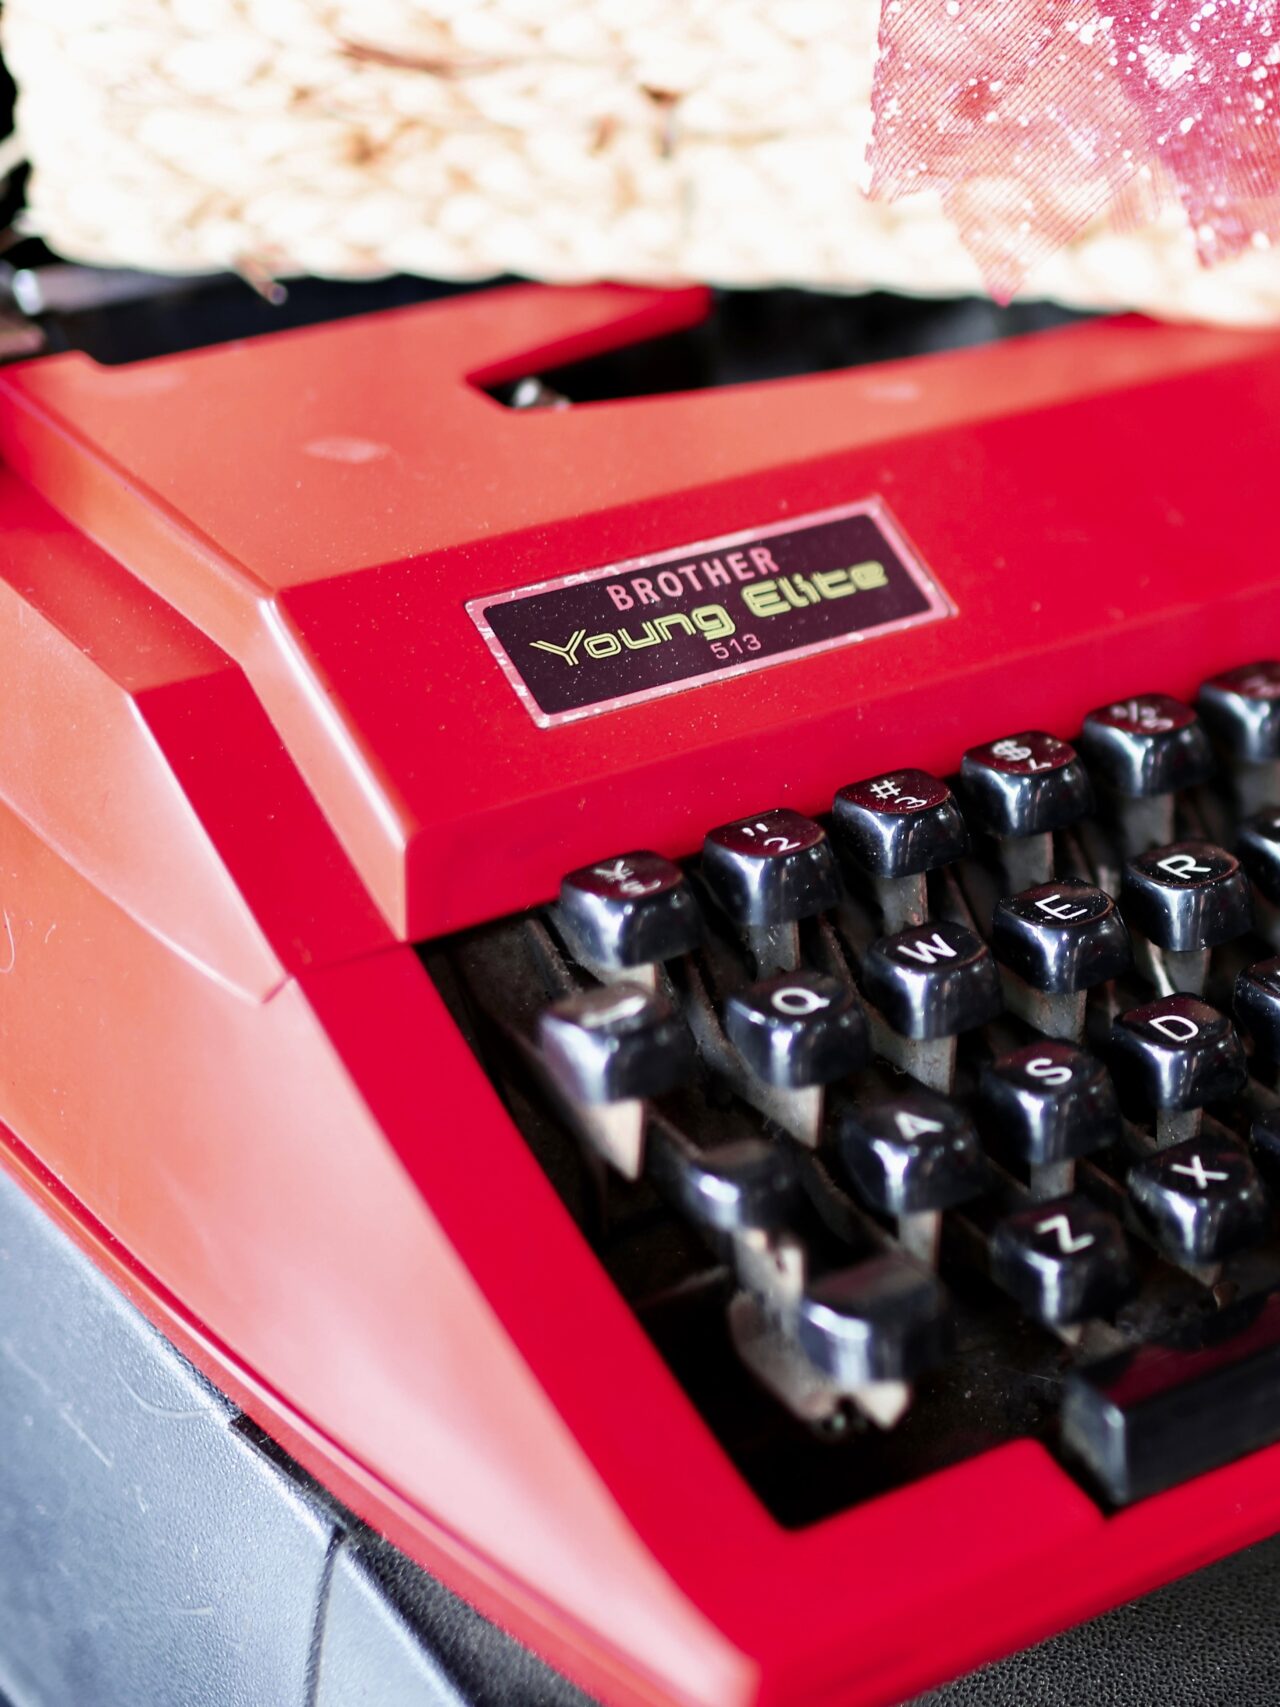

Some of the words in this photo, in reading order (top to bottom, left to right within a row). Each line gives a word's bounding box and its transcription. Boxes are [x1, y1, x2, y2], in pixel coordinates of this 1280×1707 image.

[607, 546, 780, 611] BROTHER
[529, 604, 736, 667] Young
[740, 560, 889, 618] Elite
[710, 633, 762, 660] 513
[869, 780, 901, 799] #
[894, 796, 929, 810] 3
[764, 837, 801, 852] 2
[1157, 854, 1212, 880] R
[1034, 894, 1088, 920] E
[897, 933, 957, 965] W
[771, 987, 831, 1016] Q
[1149, 1015, 1199, 1043] D
[1025, 1058, 1073, 1085] S
[895, 1111, 943, 1142] A
[1170, 1155, 1229, 1189] X
[1035, 1214, 1095, 1253] Z
